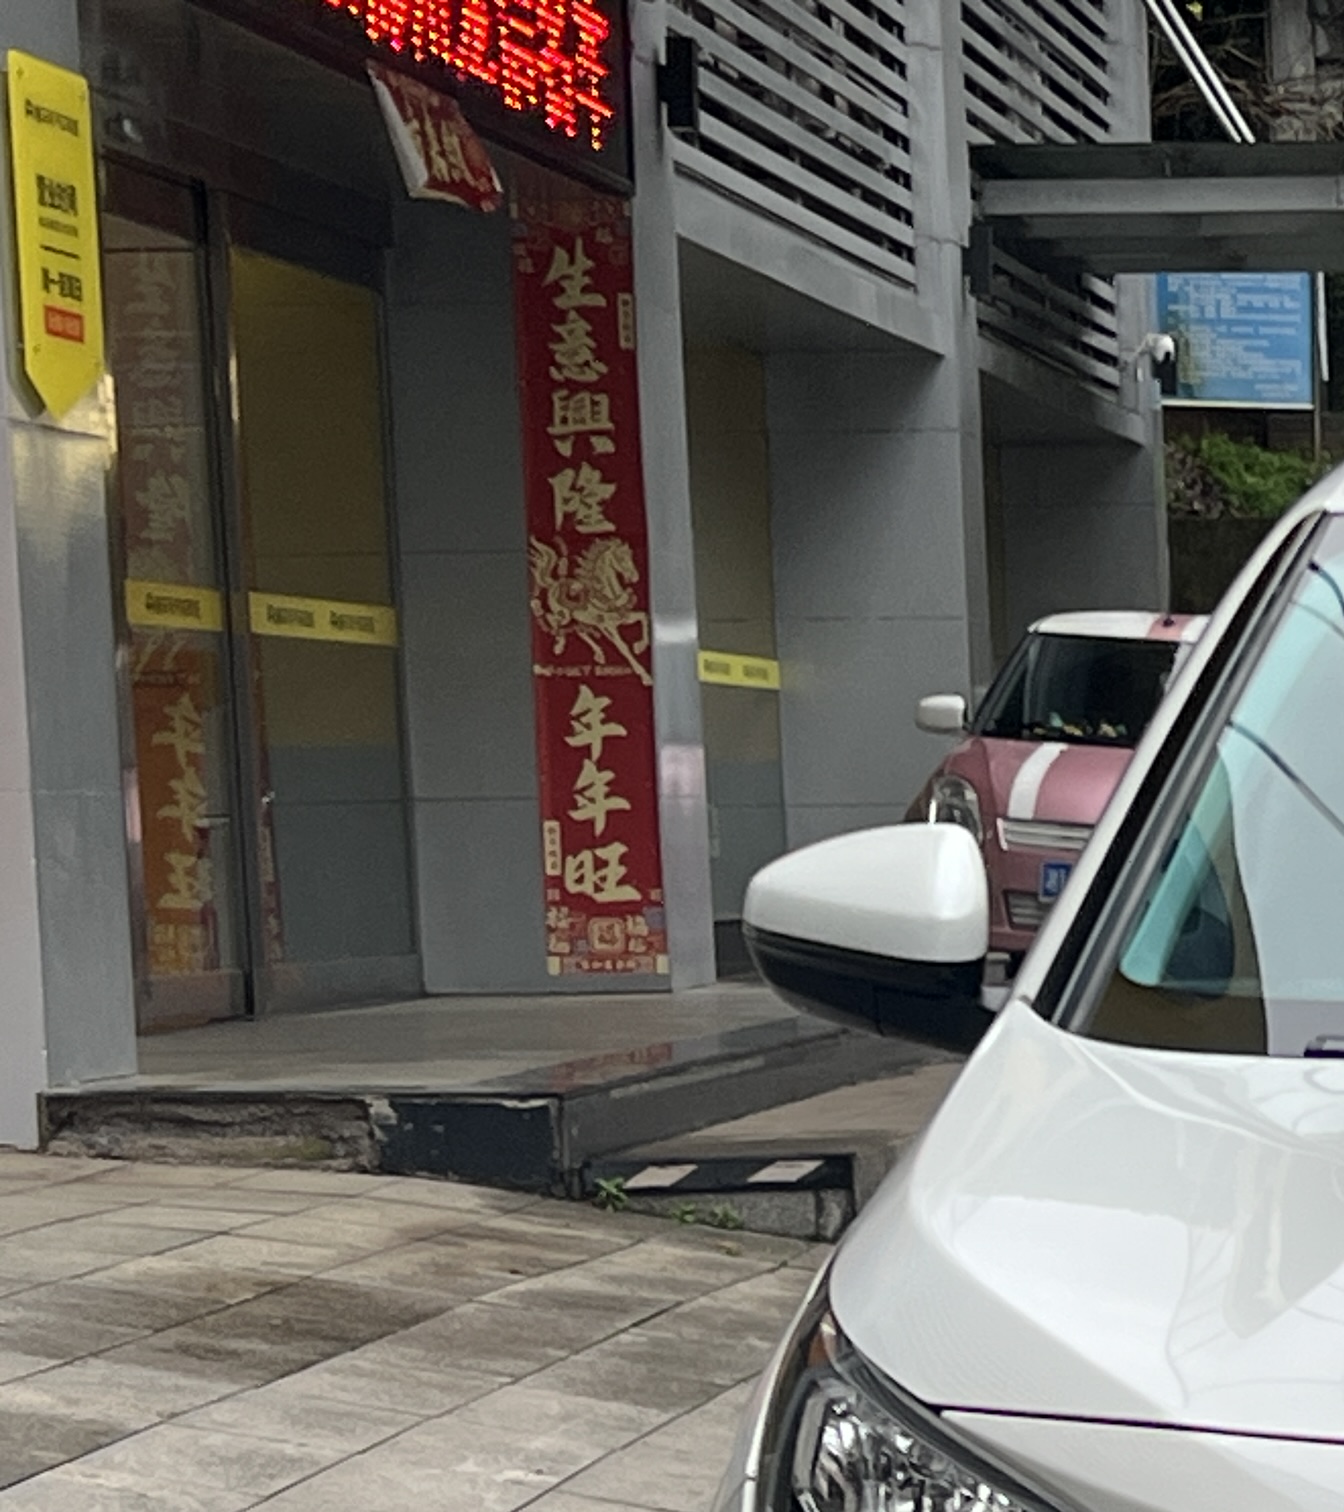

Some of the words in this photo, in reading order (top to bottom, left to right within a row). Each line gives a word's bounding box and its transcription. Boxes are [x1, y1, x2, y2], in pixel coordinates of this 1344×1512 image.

[542, 235, 619, 534] 生意興隆
[563, 684, 643, 904] 年年旺
